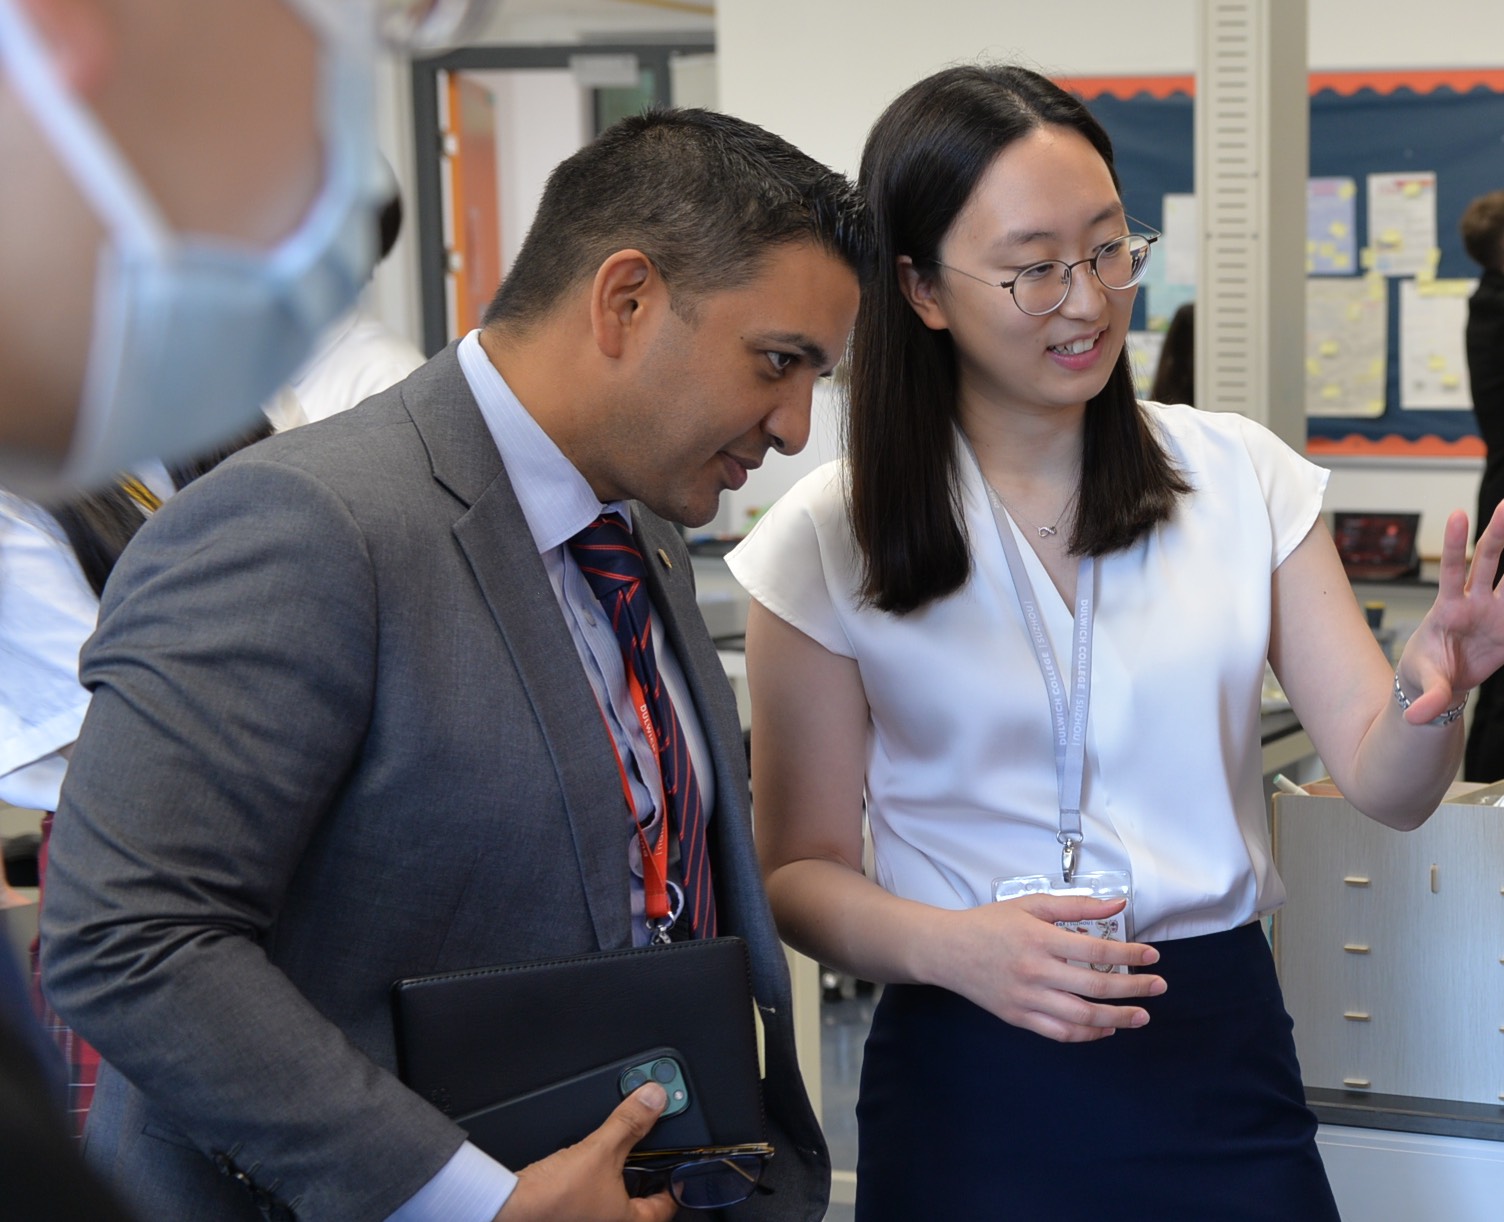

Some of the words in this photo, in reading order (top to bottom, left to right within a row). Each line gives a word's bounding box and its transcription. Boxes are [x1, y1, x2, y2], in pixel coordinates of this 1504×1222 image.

[1025, 605, 1045, 643] SUZHOU
[1079, 599, 1089, 643] DULWICH
[1041, 651, 1060, 695] COLLEGE
[1077, 646, 1087, 689] COLLEGE
[1054, 698, 1067, 746] DULWICH
[1072, 700, 1084, 739] SUZHOU
